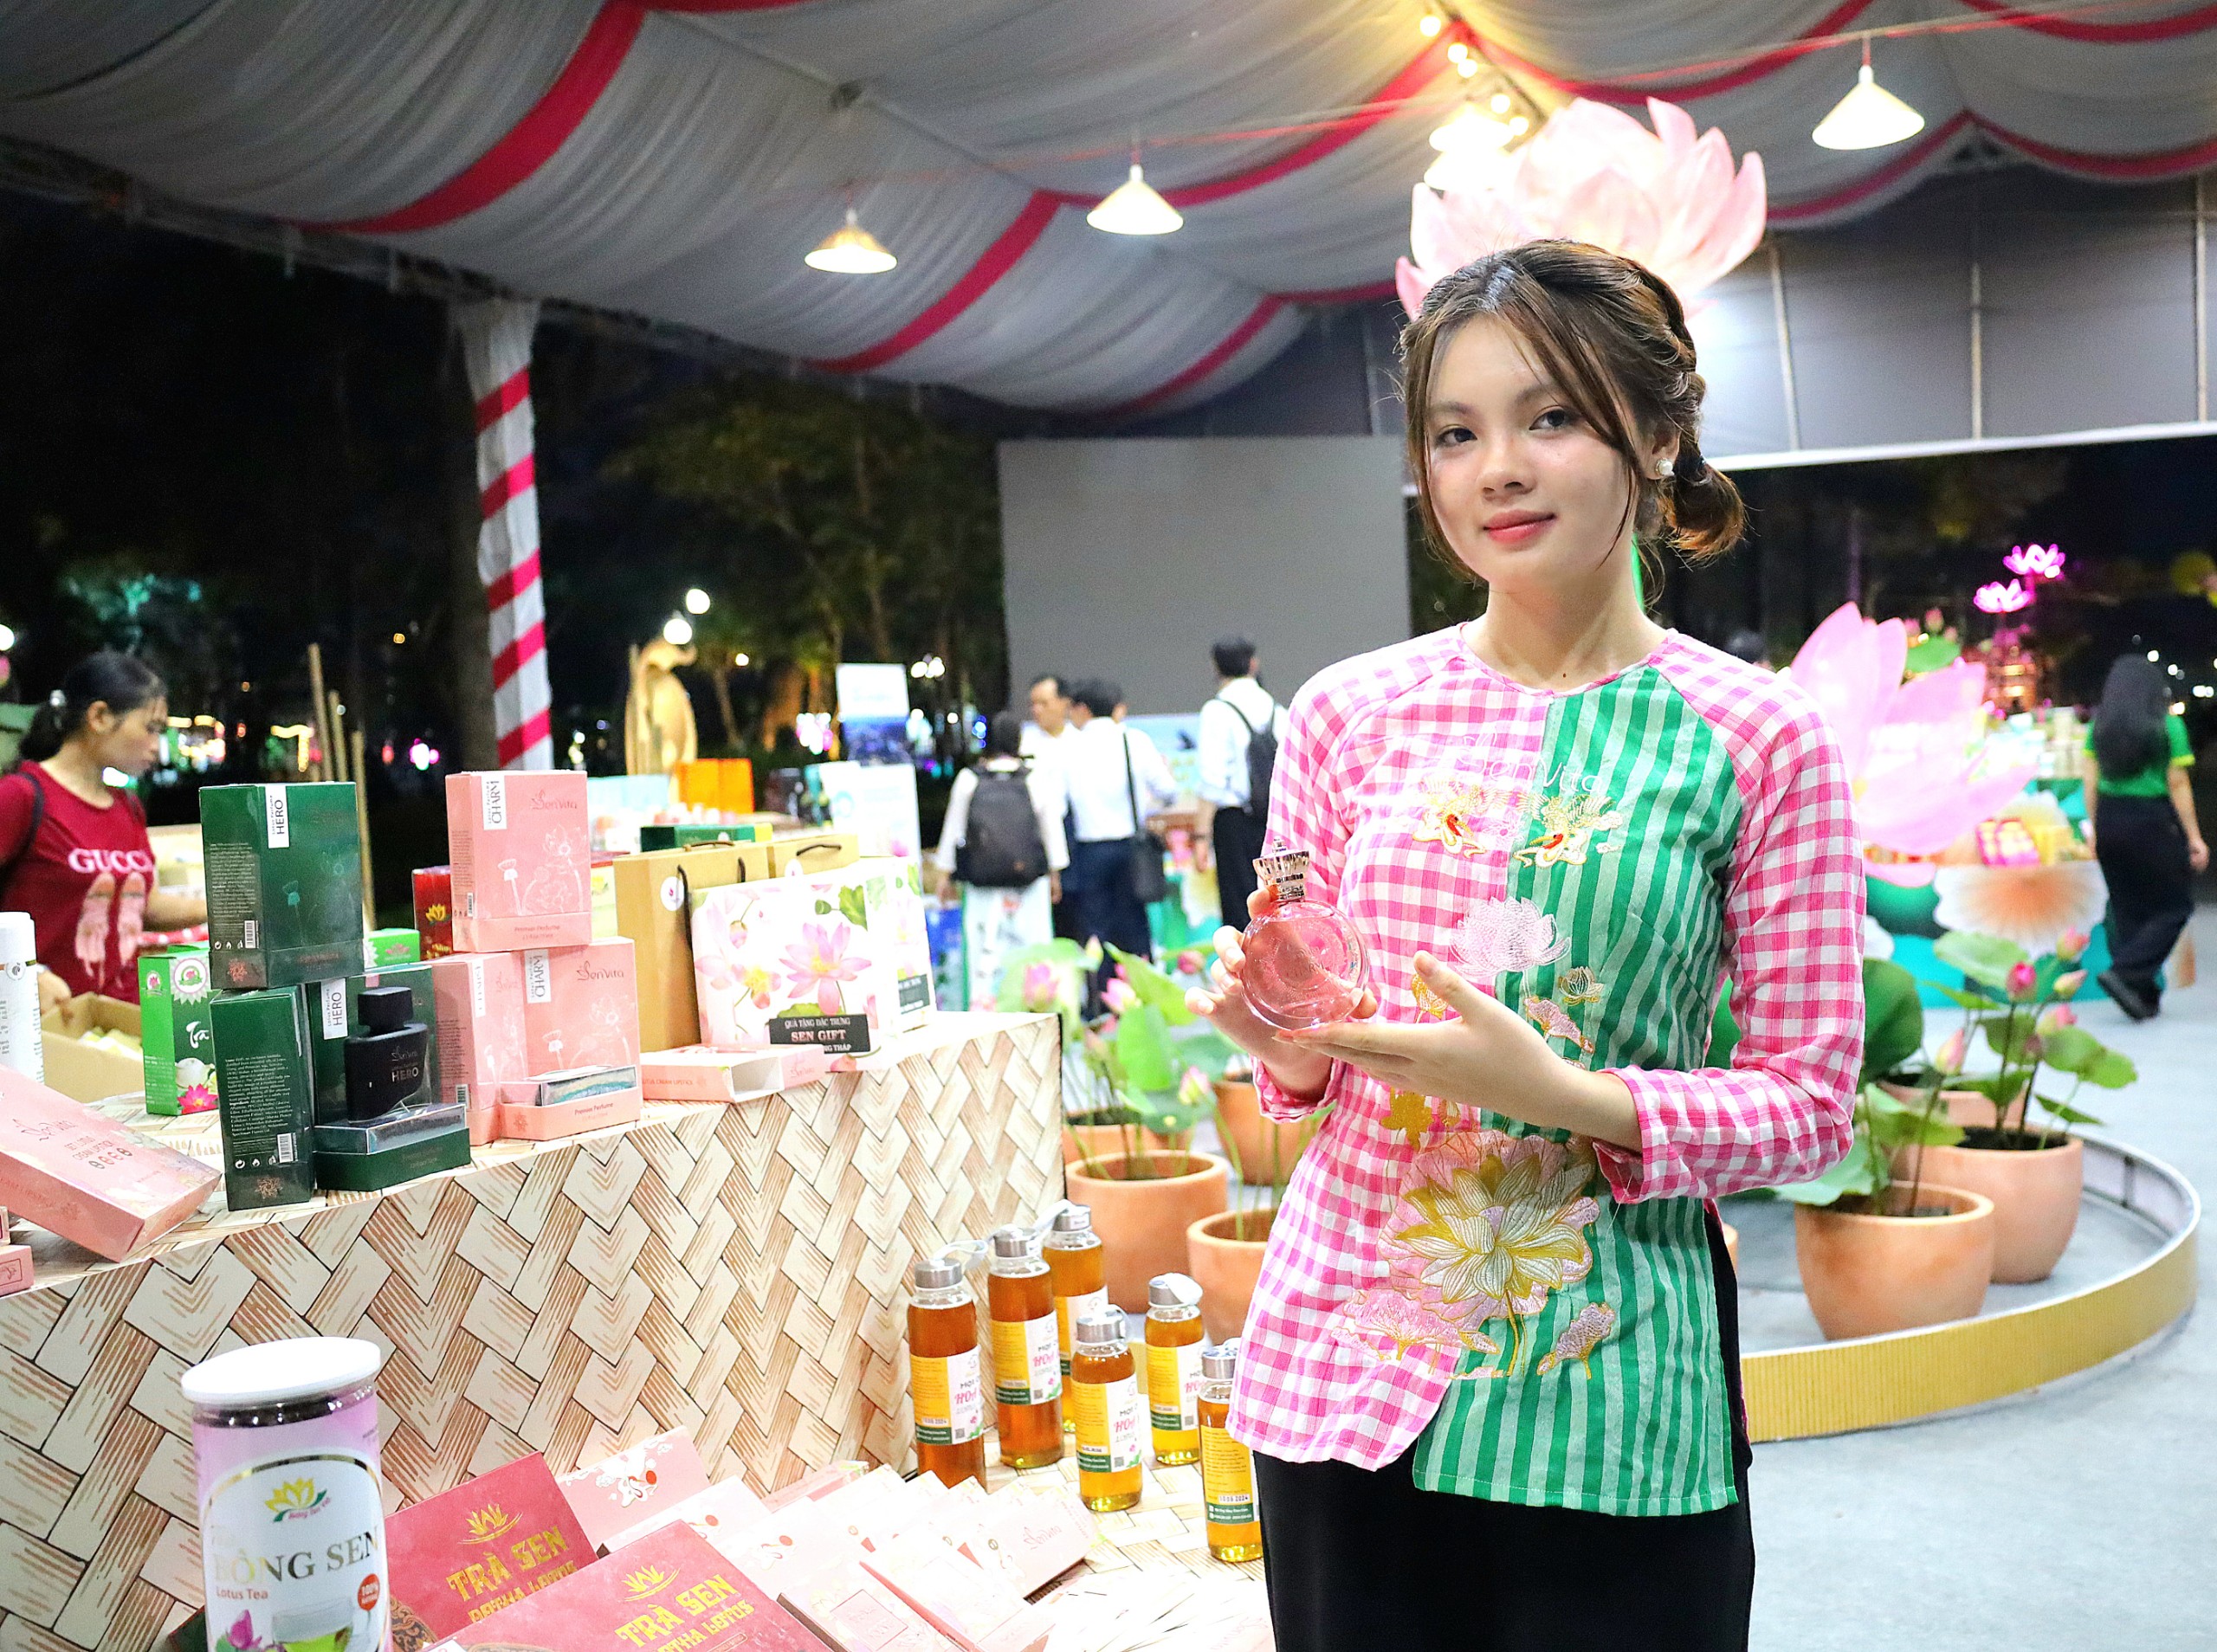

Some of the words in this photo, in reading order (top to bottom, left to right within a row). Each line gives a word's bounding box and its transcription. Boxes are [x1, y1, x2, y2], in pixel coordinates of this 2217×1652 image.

[275, 799, 285, 835] HERO
[490, 780, 502, 824] CHARM
[533, 955, 546, 997] CHARM
[331, 992, 343, 1026] HERO
[791, 1030, 814, 1042] SEN
[818, 1029, 846, 1041] GIFT
[391, 1067, 419, 1082] HERO
[326, 1526, 378, 1571] SEN
[446, 1552, 513, 1602] TRÀ
[511, 1526, 570, 1571] SEN
[217, 1586, 243, 1600] Lotus
[247, 1588, 268, 1600] Tea
[614, 1604, 686, 1648] TRÀ
[675, 1574, 739, 1617] SEN
[701, 1599, 755, 1636] LOTUS
